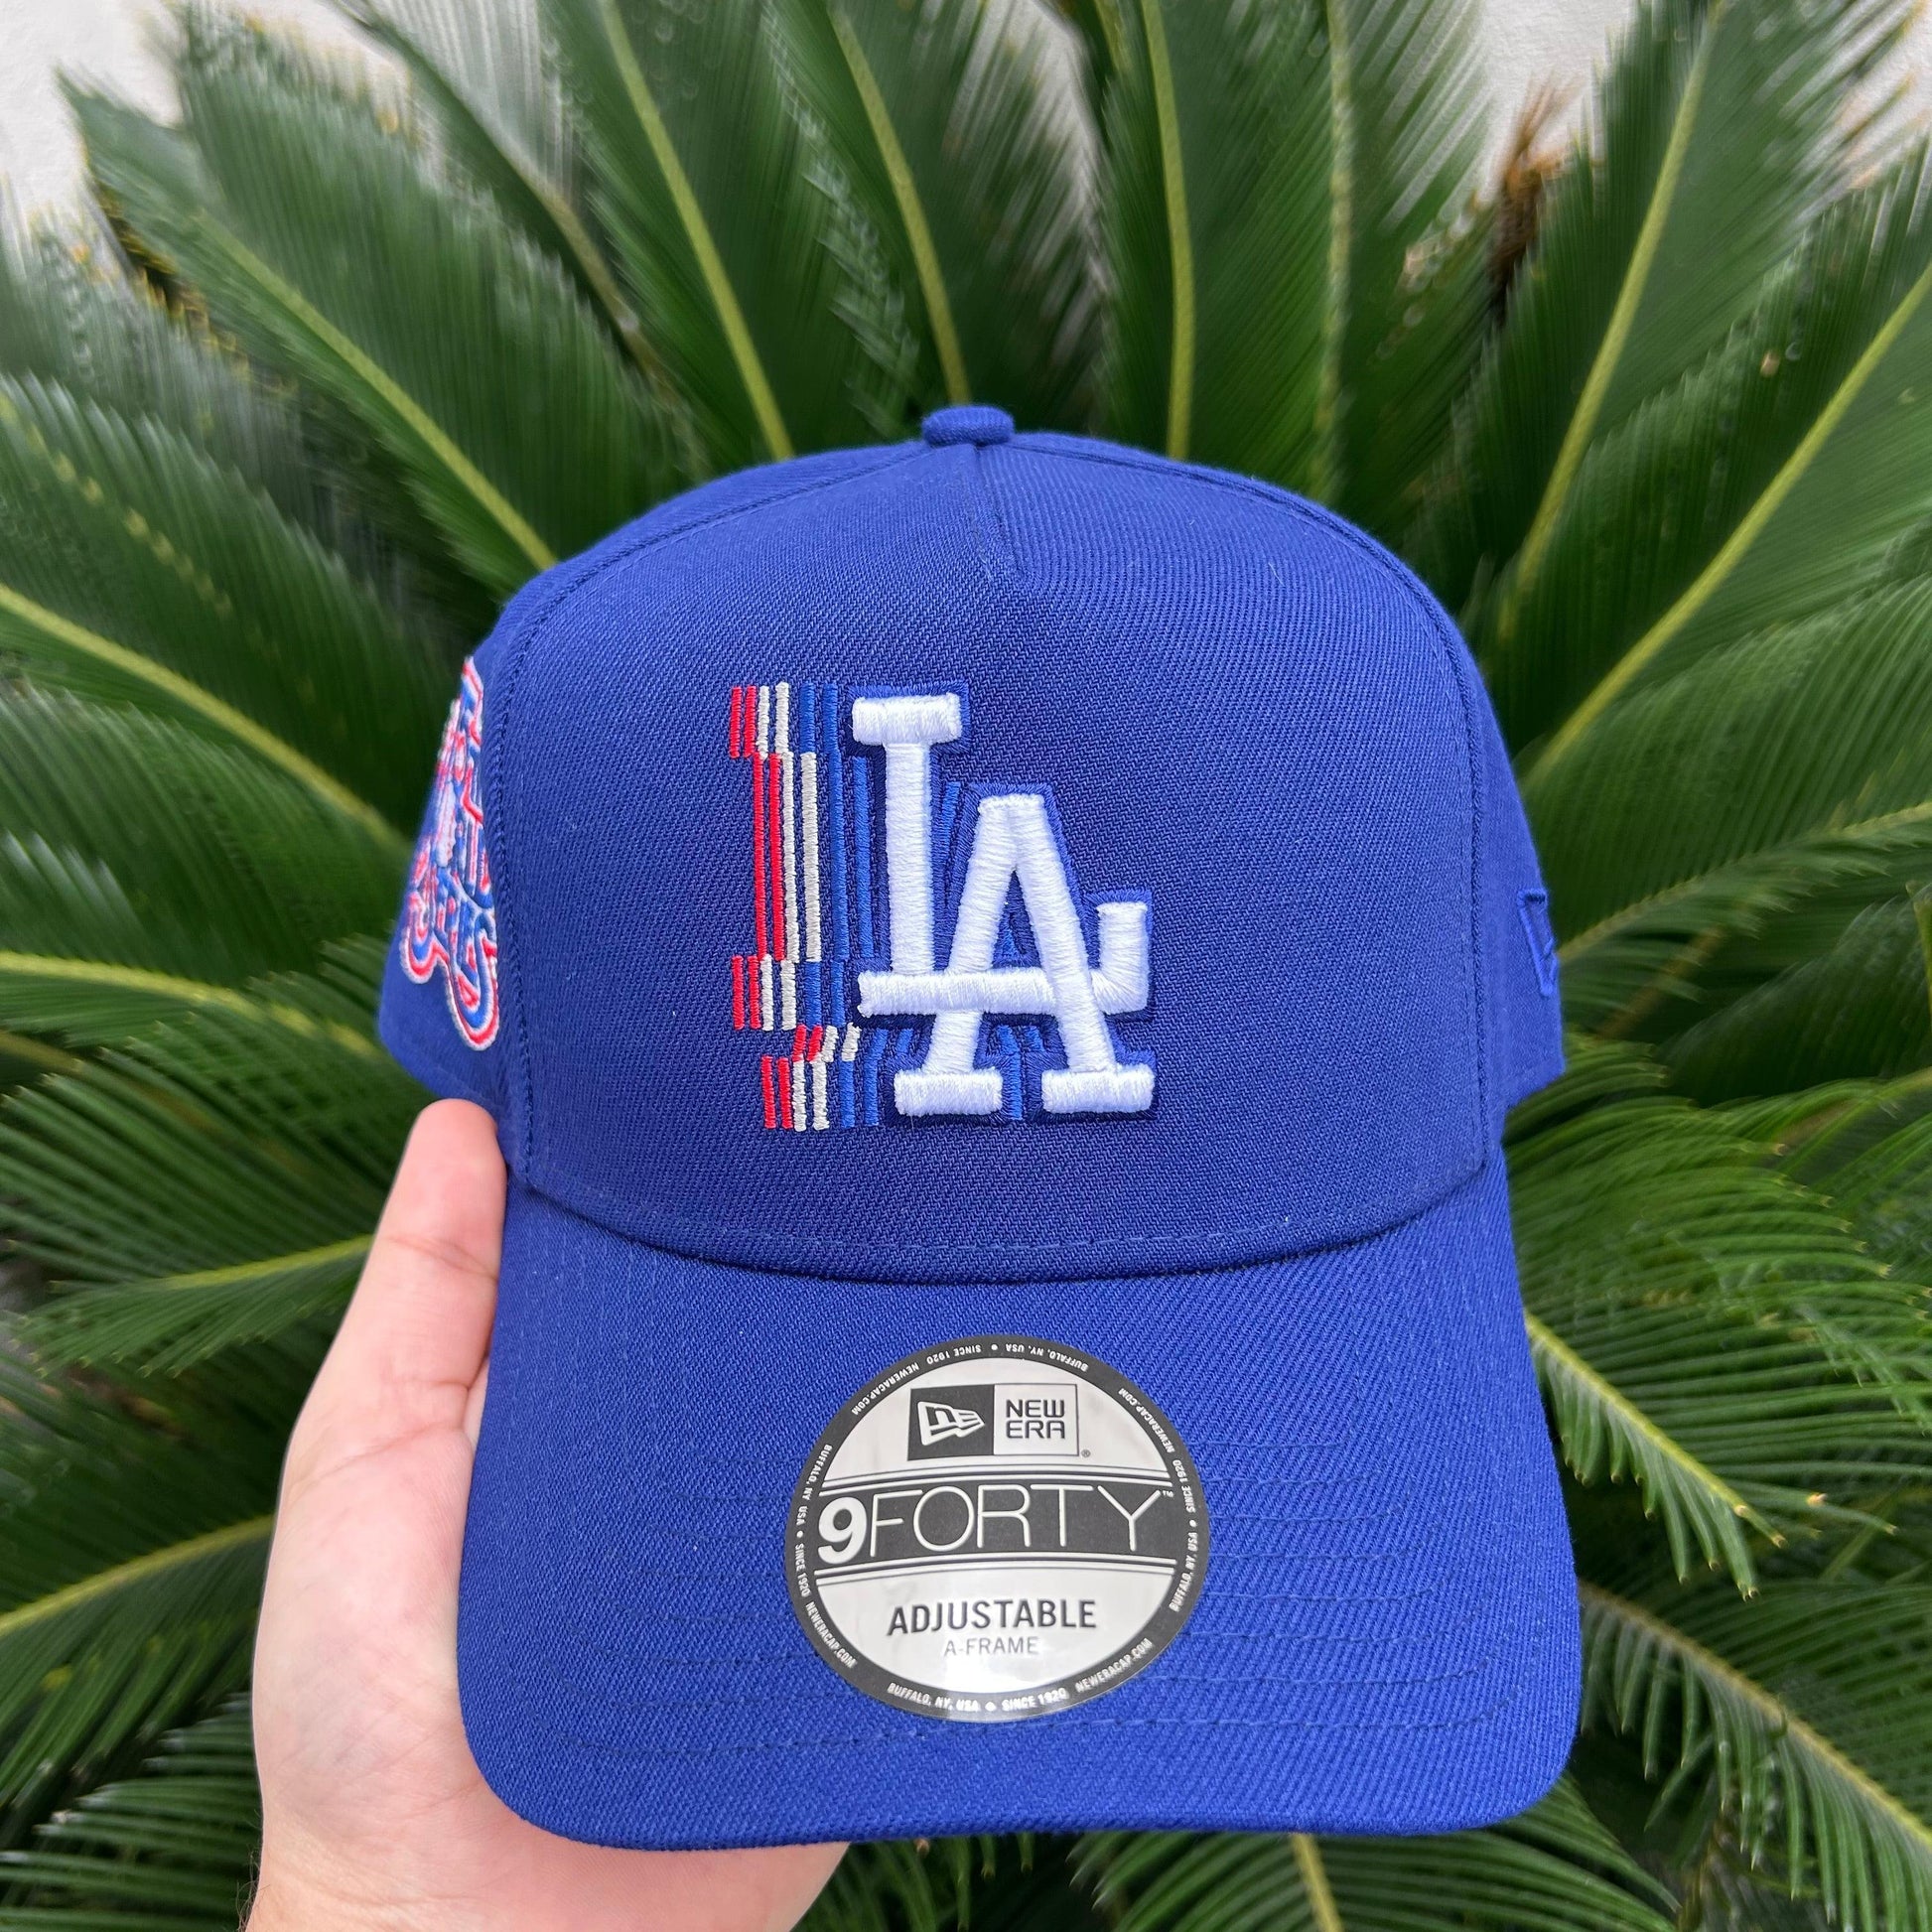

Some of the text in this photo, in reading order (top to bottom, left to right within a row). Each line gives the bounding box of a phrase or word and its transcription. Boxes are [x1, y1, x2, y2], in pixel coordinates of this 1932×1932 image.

[852, 693, 1155, 1116] LA
[926, 1350, 950, 1364] 1920
[953, 1344, 981, 1356] SINCE
[1005, 1343, 1025, 1352] USA
[851, 1362, 919, 1415] NEWERACAP.COM
[1006, 1399, 1065, 1418] NEW
[1118, 1388, 1175, 1453] NEWERACAP.COM
[1006, 1420, 1065, 1439] ERA
[1173, 1459, 1188, 1483] 1920
[1181, 1485, 1196, 1513] SINCE
[796, 1505, 808, 1526] USA
[817, 1484, 1162, 1564] 9FORTY
[1187, 1532, 1198, 1552] USA
[794, 1543, 806, 1572] SINCE
[797, 1573, 812, 1597] 1920
[887, 1599, 1097, 1636] ADJUSTABLE
[805, 1601, 858, 1668] NEWERACAP.COM
[943, 1636, 1039, 1656] A-FRAME
[955, 1699, 981, 1712] USA
[1002, 1695, 1037, 1712] SINCE
[1037, 1688, 1070, 1705] 1920
[1075, 1637, 1155, 1693] NEWERACAP.COM
